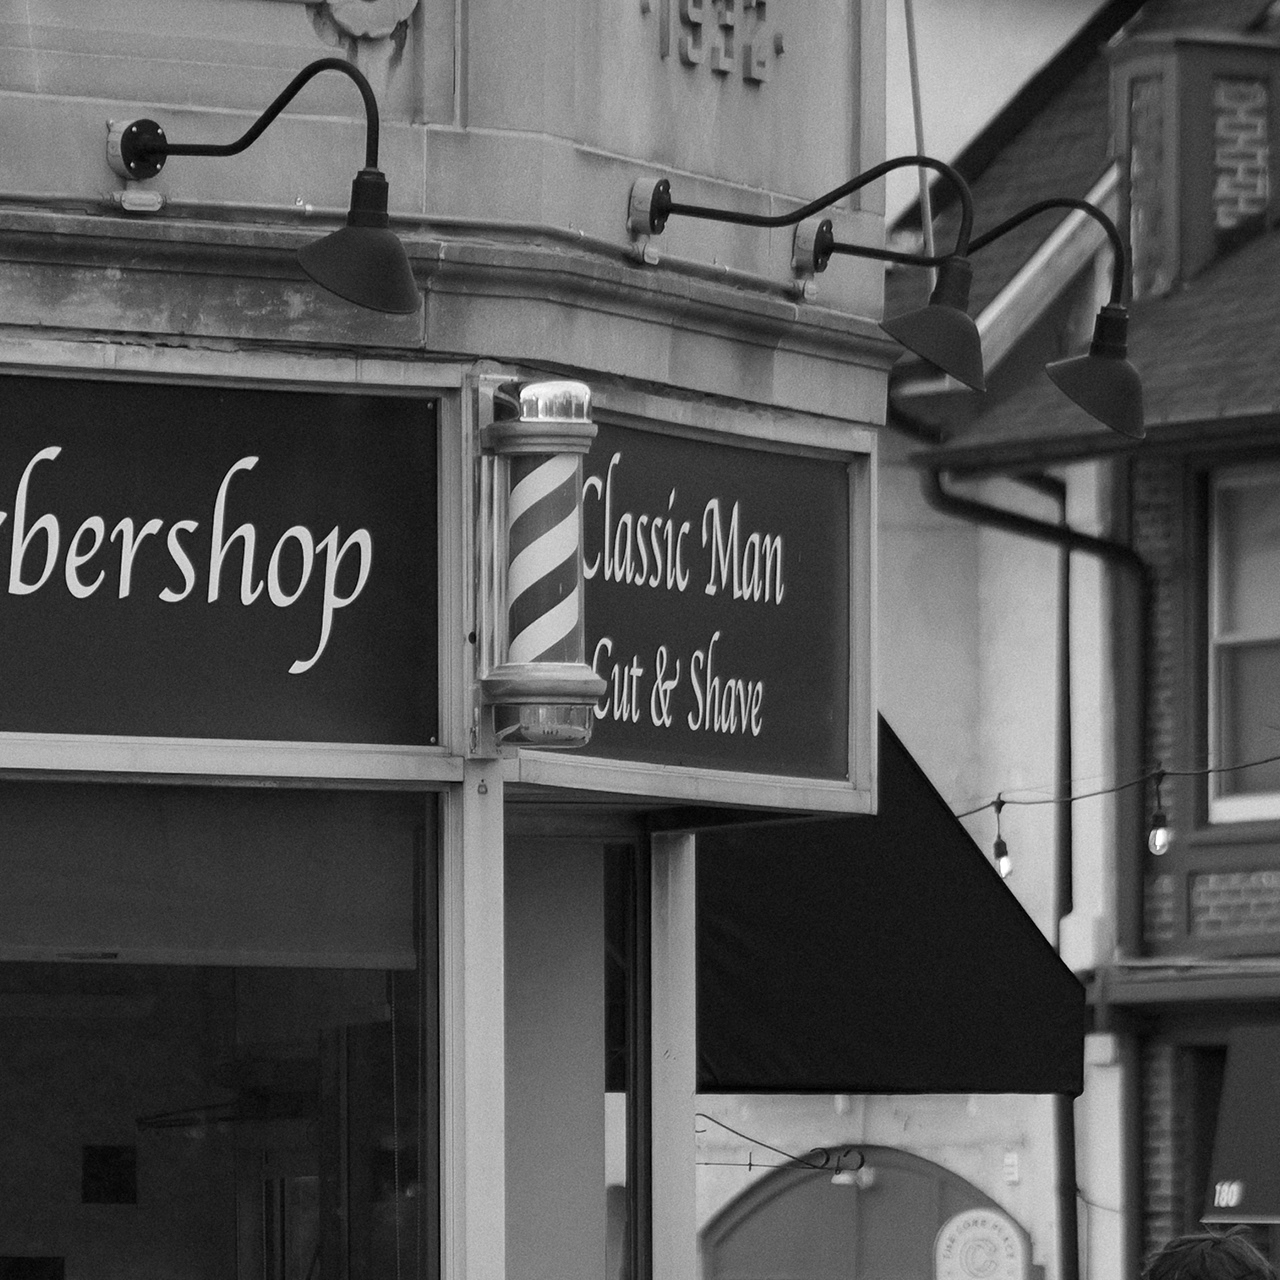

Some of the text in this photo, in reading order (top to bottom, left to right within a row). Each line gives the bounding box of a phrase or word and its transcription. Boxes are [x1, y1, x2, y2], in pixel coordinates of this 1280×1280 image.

[582, 452, 785, 605] Classic Man
[592, 631, 763, 737] Cut & Shave
